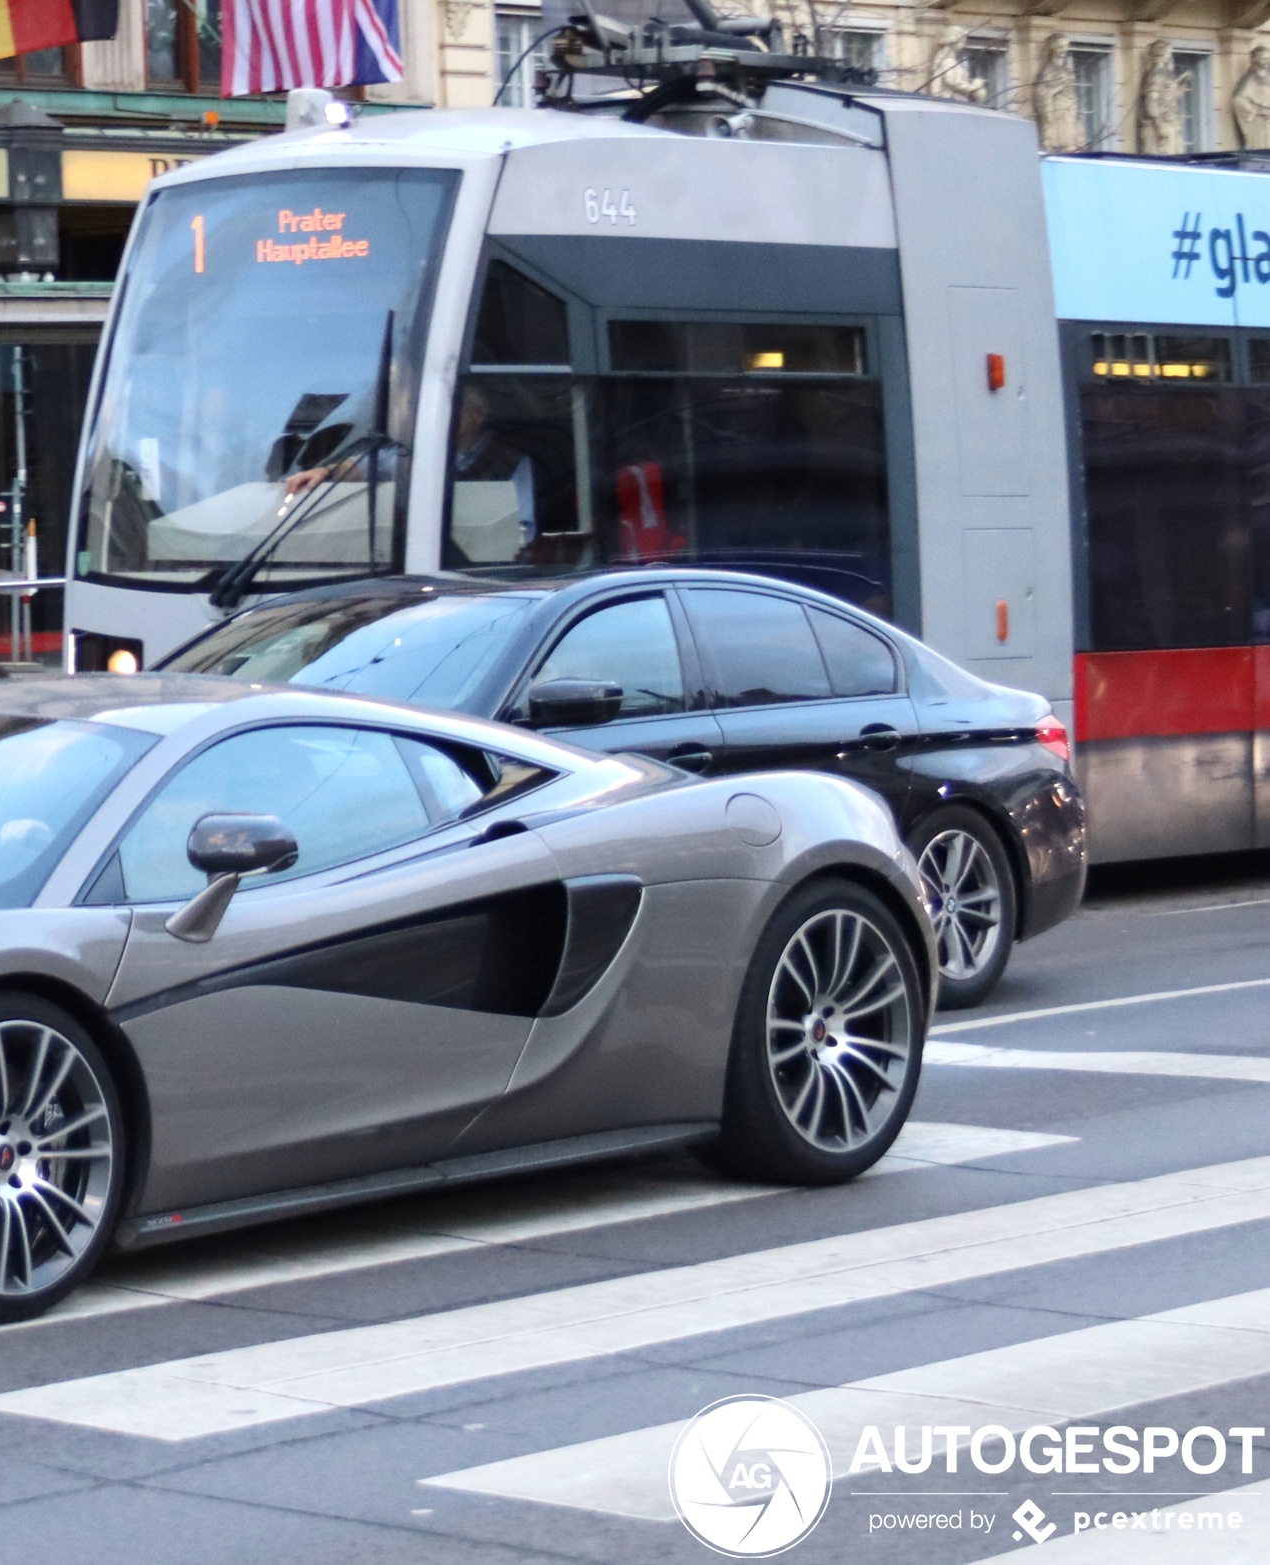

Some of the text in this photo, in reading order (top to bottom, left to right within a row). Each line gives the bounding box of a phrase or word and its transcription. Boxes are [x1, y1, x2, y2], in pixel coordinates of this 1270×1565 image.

[278, 208, 346, 233] Prater
[584, 187, 637, 226] 644
[191, 215, 205, 273] 1
[256, 235, 370, 265] Hauptallee
